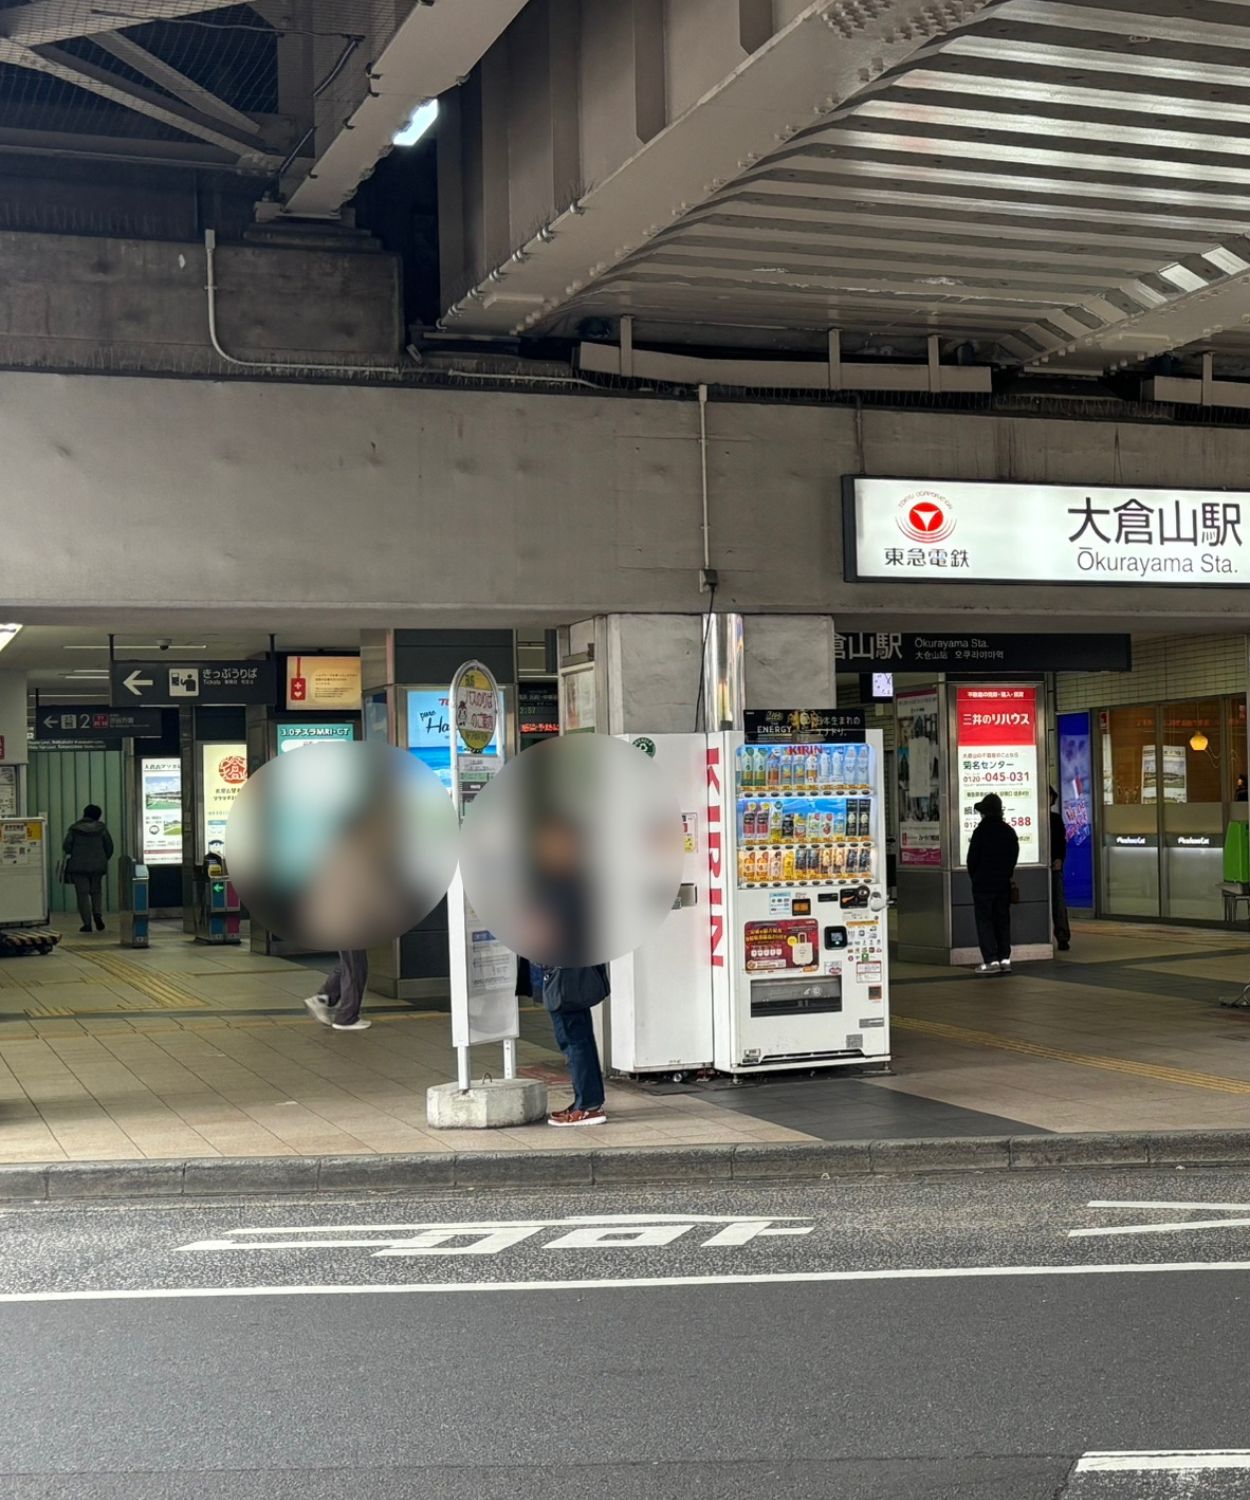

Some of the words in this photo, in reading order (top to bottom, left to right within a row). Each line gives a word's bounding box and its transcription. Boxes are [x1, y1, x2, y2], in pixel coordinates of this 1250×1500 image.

[1067, 497, 1243, 547] 大倉山駅
[883, 547, 970, 568] 東急電鉄
[1076, 546, 1193, 577] Ōkurayama
[1200, 553, 1239, 574] Sta.
[202, 667, 258, 679] きっぷうりば
[80, 713, 91, 729] 2
[962, 713, 1031, 726] 三井のリハウス
[756, 725, 793, 734] ENERGY
[788, 745, 823, 756] KIRIN
[963, 760, 1015, 770] 菊名センター
[706, 747, 724, 967] KIRIN
